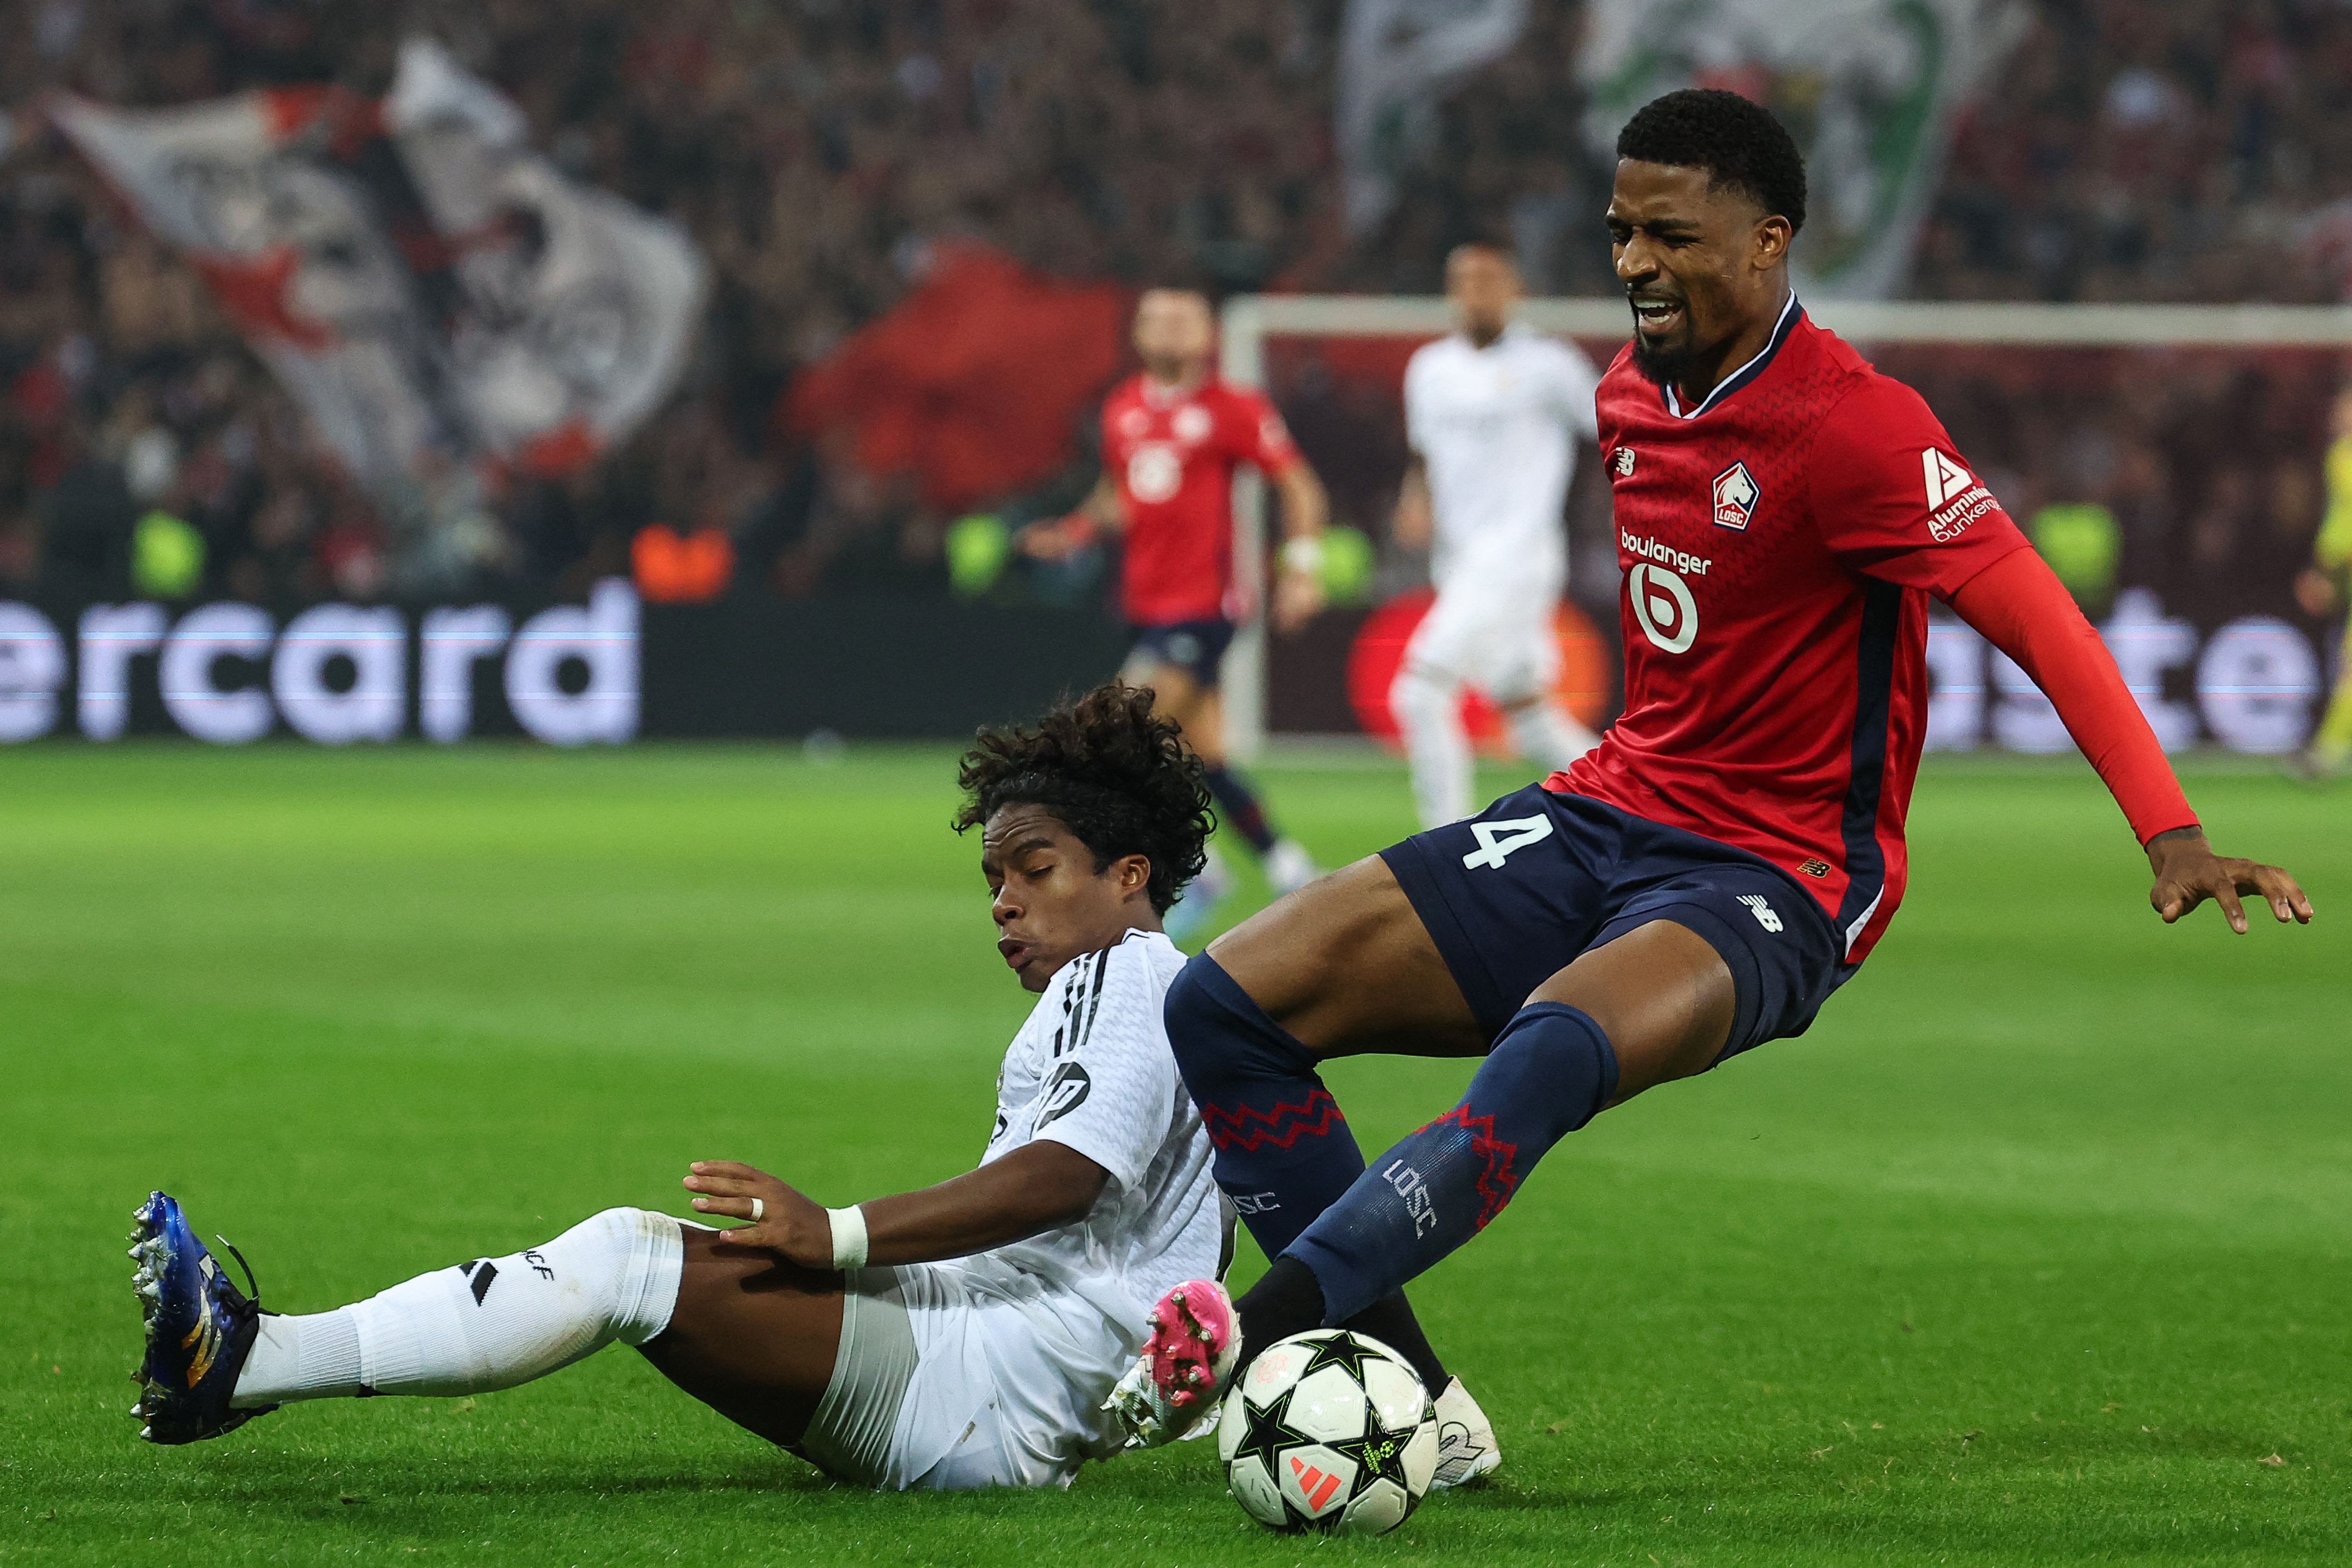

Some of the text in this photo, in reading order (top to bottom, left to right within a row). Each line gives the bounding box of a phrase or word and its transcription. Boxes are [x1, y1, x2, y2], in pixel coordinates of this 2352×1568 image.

[1718, 508, 1744, 524] LOSC
[1927, 486, 1993, 536] Aluminiu
[1934, 499, 2002, 542] Dunkerq
[1621, 526, 1712, 575] boulanger
[1462, 812, 1554, 870] 4
[1382, 1159, 1437, 1240] LOSC
[1362, 1449, 1374, 1472] LEAGUE
[1364, 1440, 1381, 1474] CHAMPIONS
